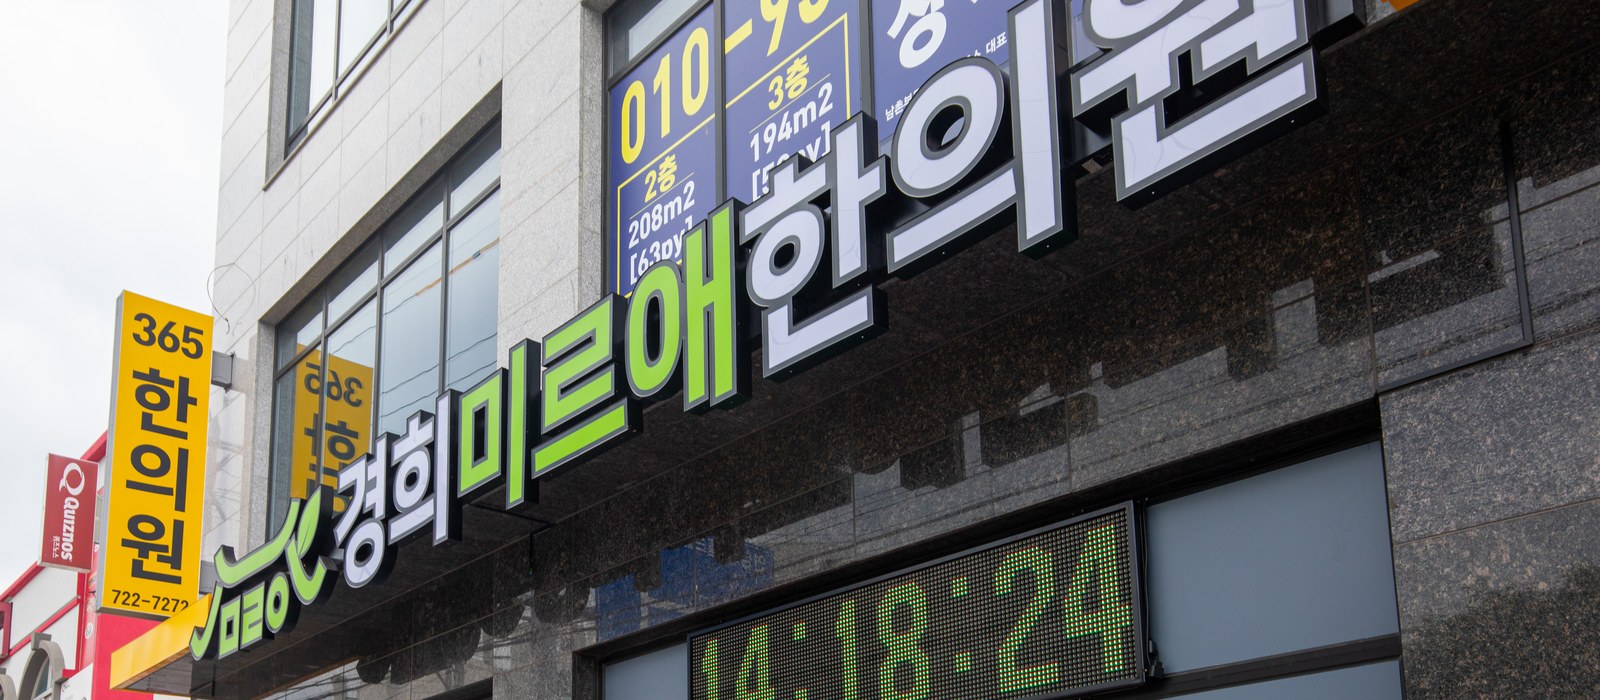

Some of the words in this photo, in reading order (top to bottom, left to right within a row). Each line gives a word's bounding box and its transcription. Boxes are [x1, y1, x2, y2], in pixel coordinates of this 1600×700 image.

[986, 31, 1007, 54] 대표
[768, 55, 810, 110] 3층
[750, 82, 834, 162] 194m2
[644, 154, 677, 203] 2층
[628, 180, 695, 249] 208m2
[132, 312, 204, 360] 365
[121, 367, 197, 585] 한의원
[112, 589, 189, 613] 722-7272
[702, 524, 1132, 700] 14:18:24
